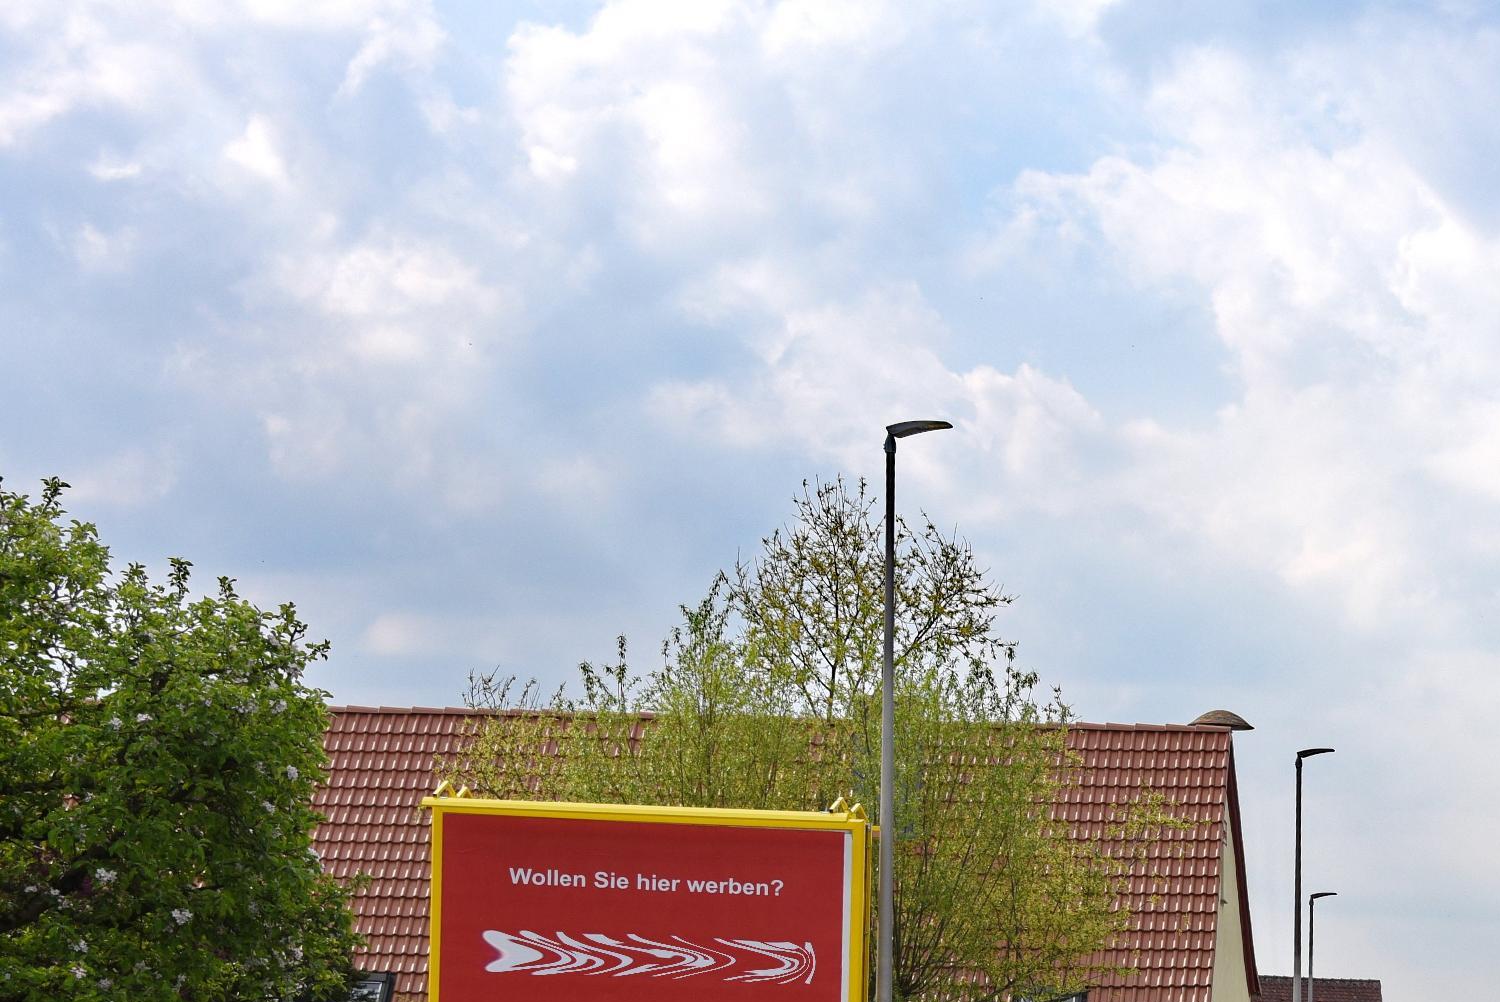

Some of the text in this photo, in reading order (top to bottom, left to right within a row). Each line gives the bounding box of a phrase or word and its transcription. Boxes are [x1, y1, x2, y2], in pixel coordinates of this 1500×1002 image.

[509, 867, 784, 897] Wollen Sie hier werben?
